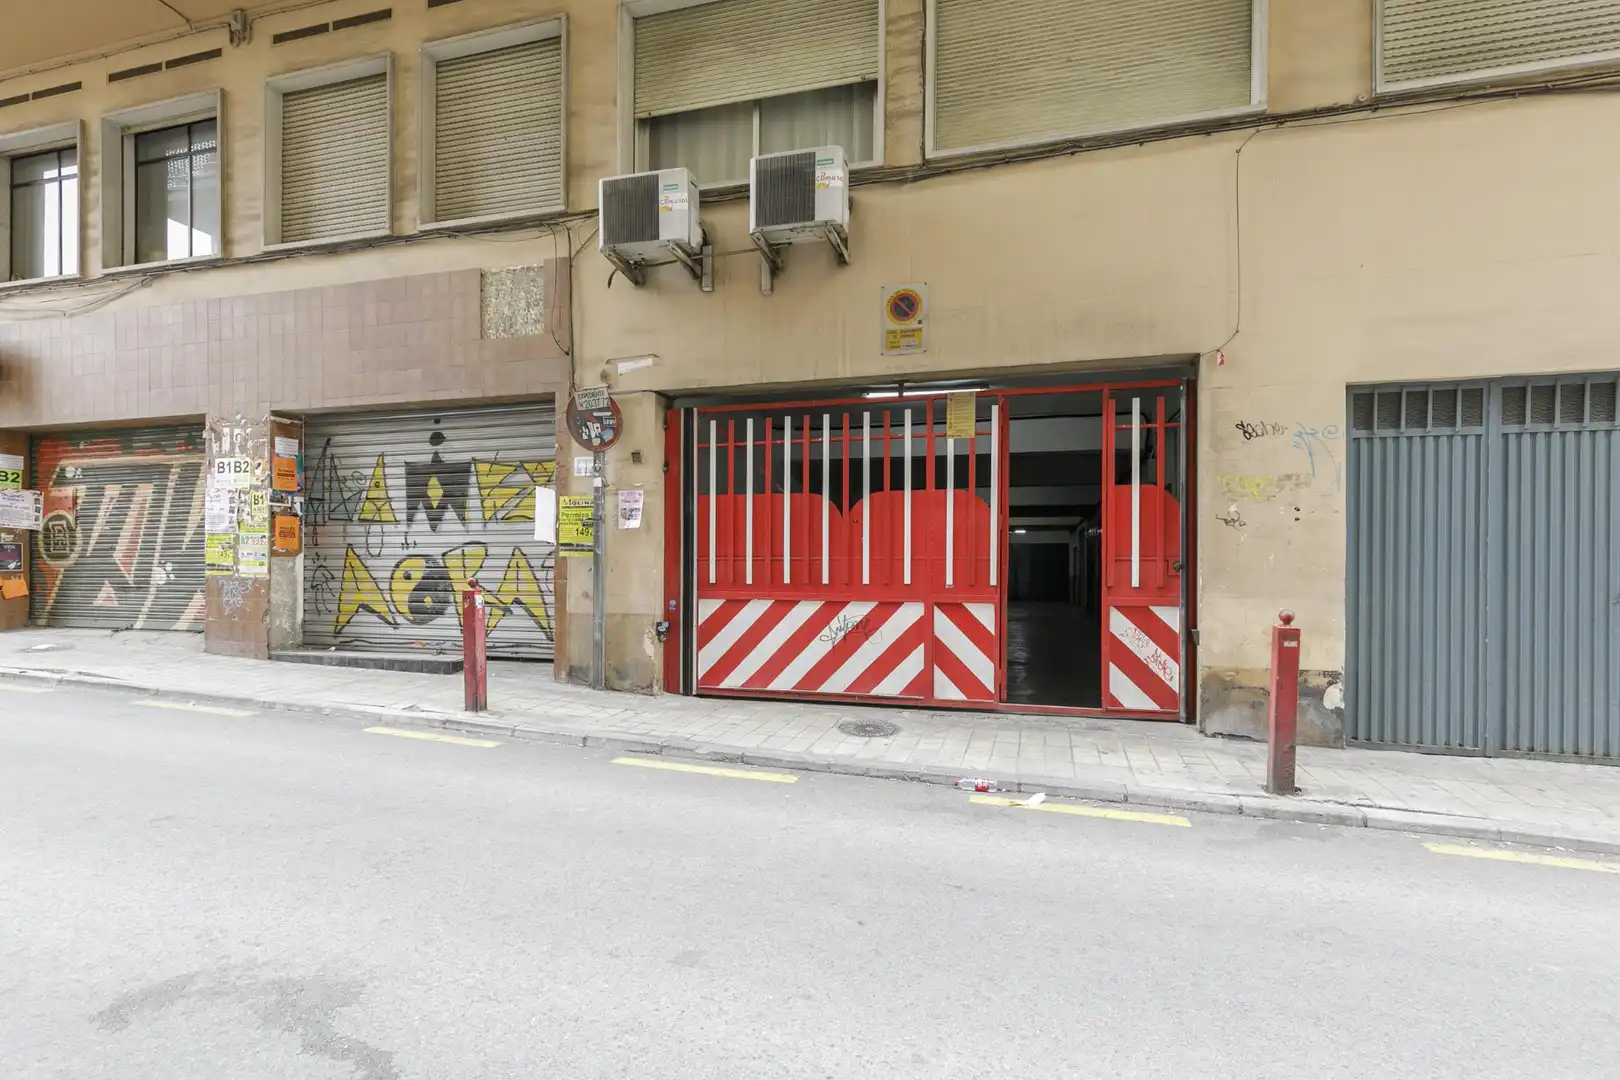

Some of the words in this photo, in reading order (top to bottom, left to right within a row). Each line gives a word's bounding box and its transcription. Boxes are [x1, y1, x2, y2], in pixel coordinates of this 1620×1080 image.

[578, 390, 605, 400] EXPEDIENTE
[217, 462, 231, 474] B1
[234, 461, 249, 473] B2
